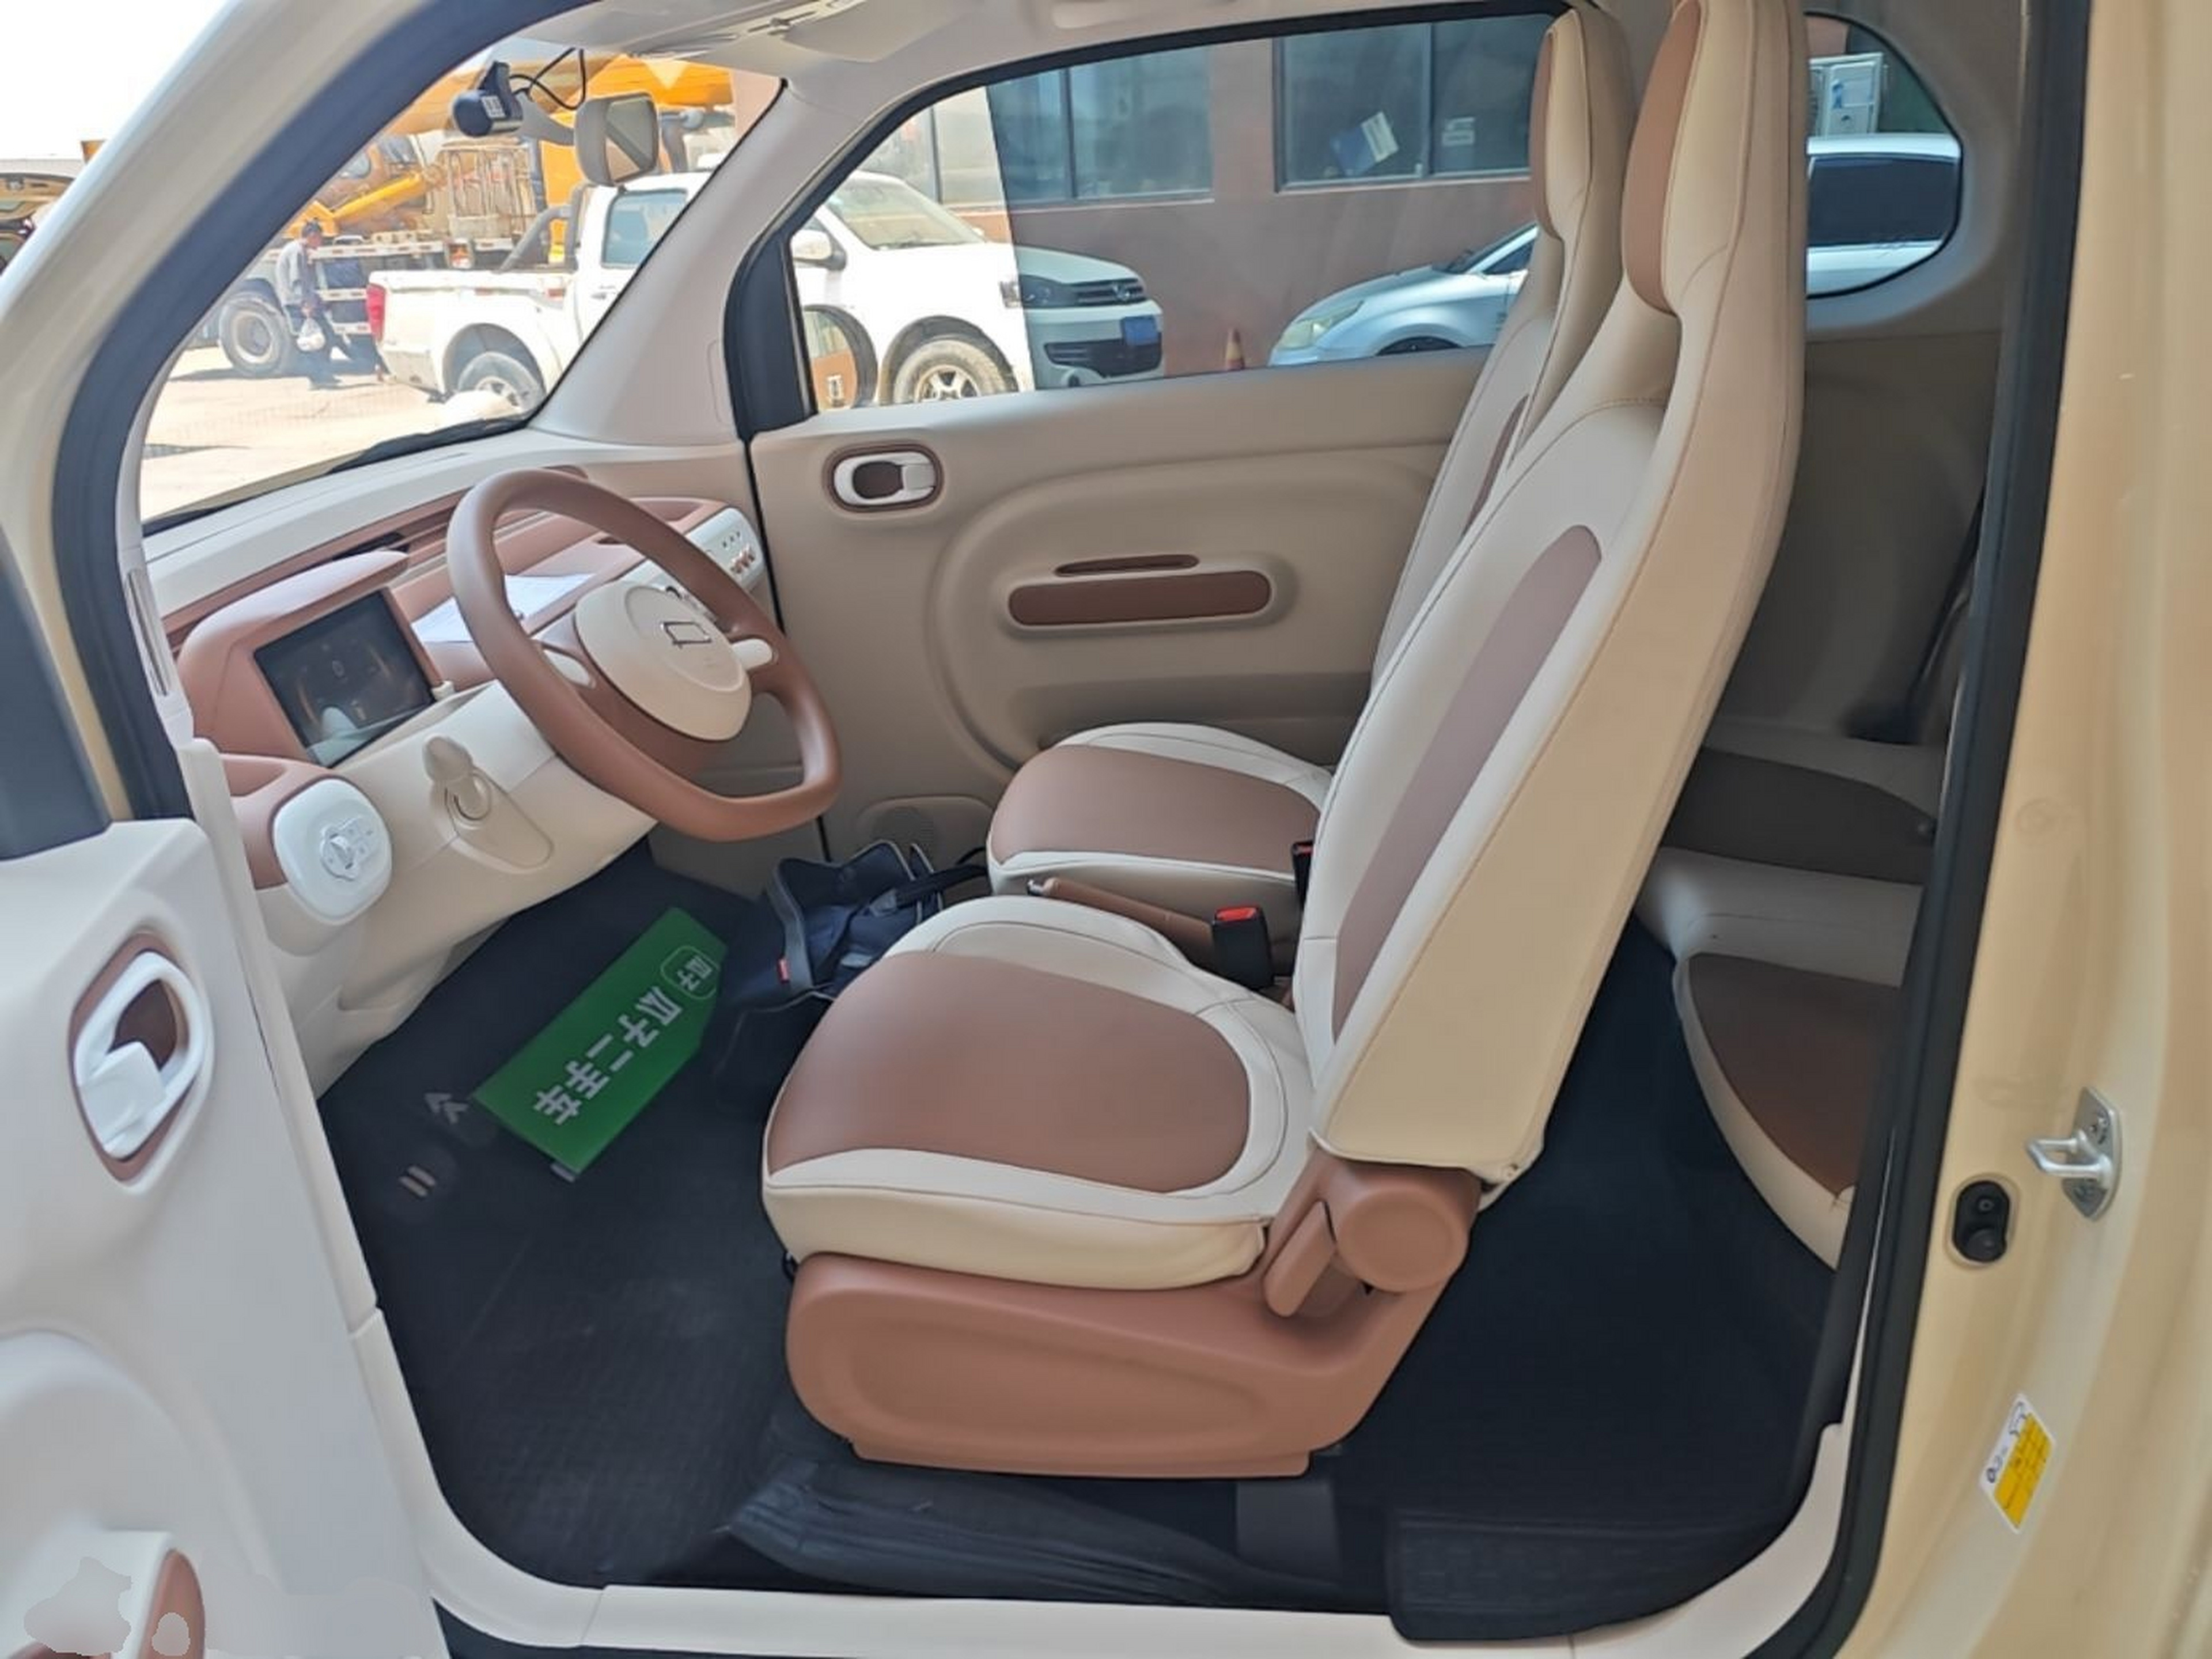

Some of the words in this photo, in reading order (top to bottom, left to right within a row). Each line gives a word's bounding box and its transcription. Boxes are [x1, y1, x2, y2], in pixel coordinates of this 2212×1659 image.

[677, 957, 712, 991] 瓜子
[533, 986, 682, 1125] 瓜子二手车
